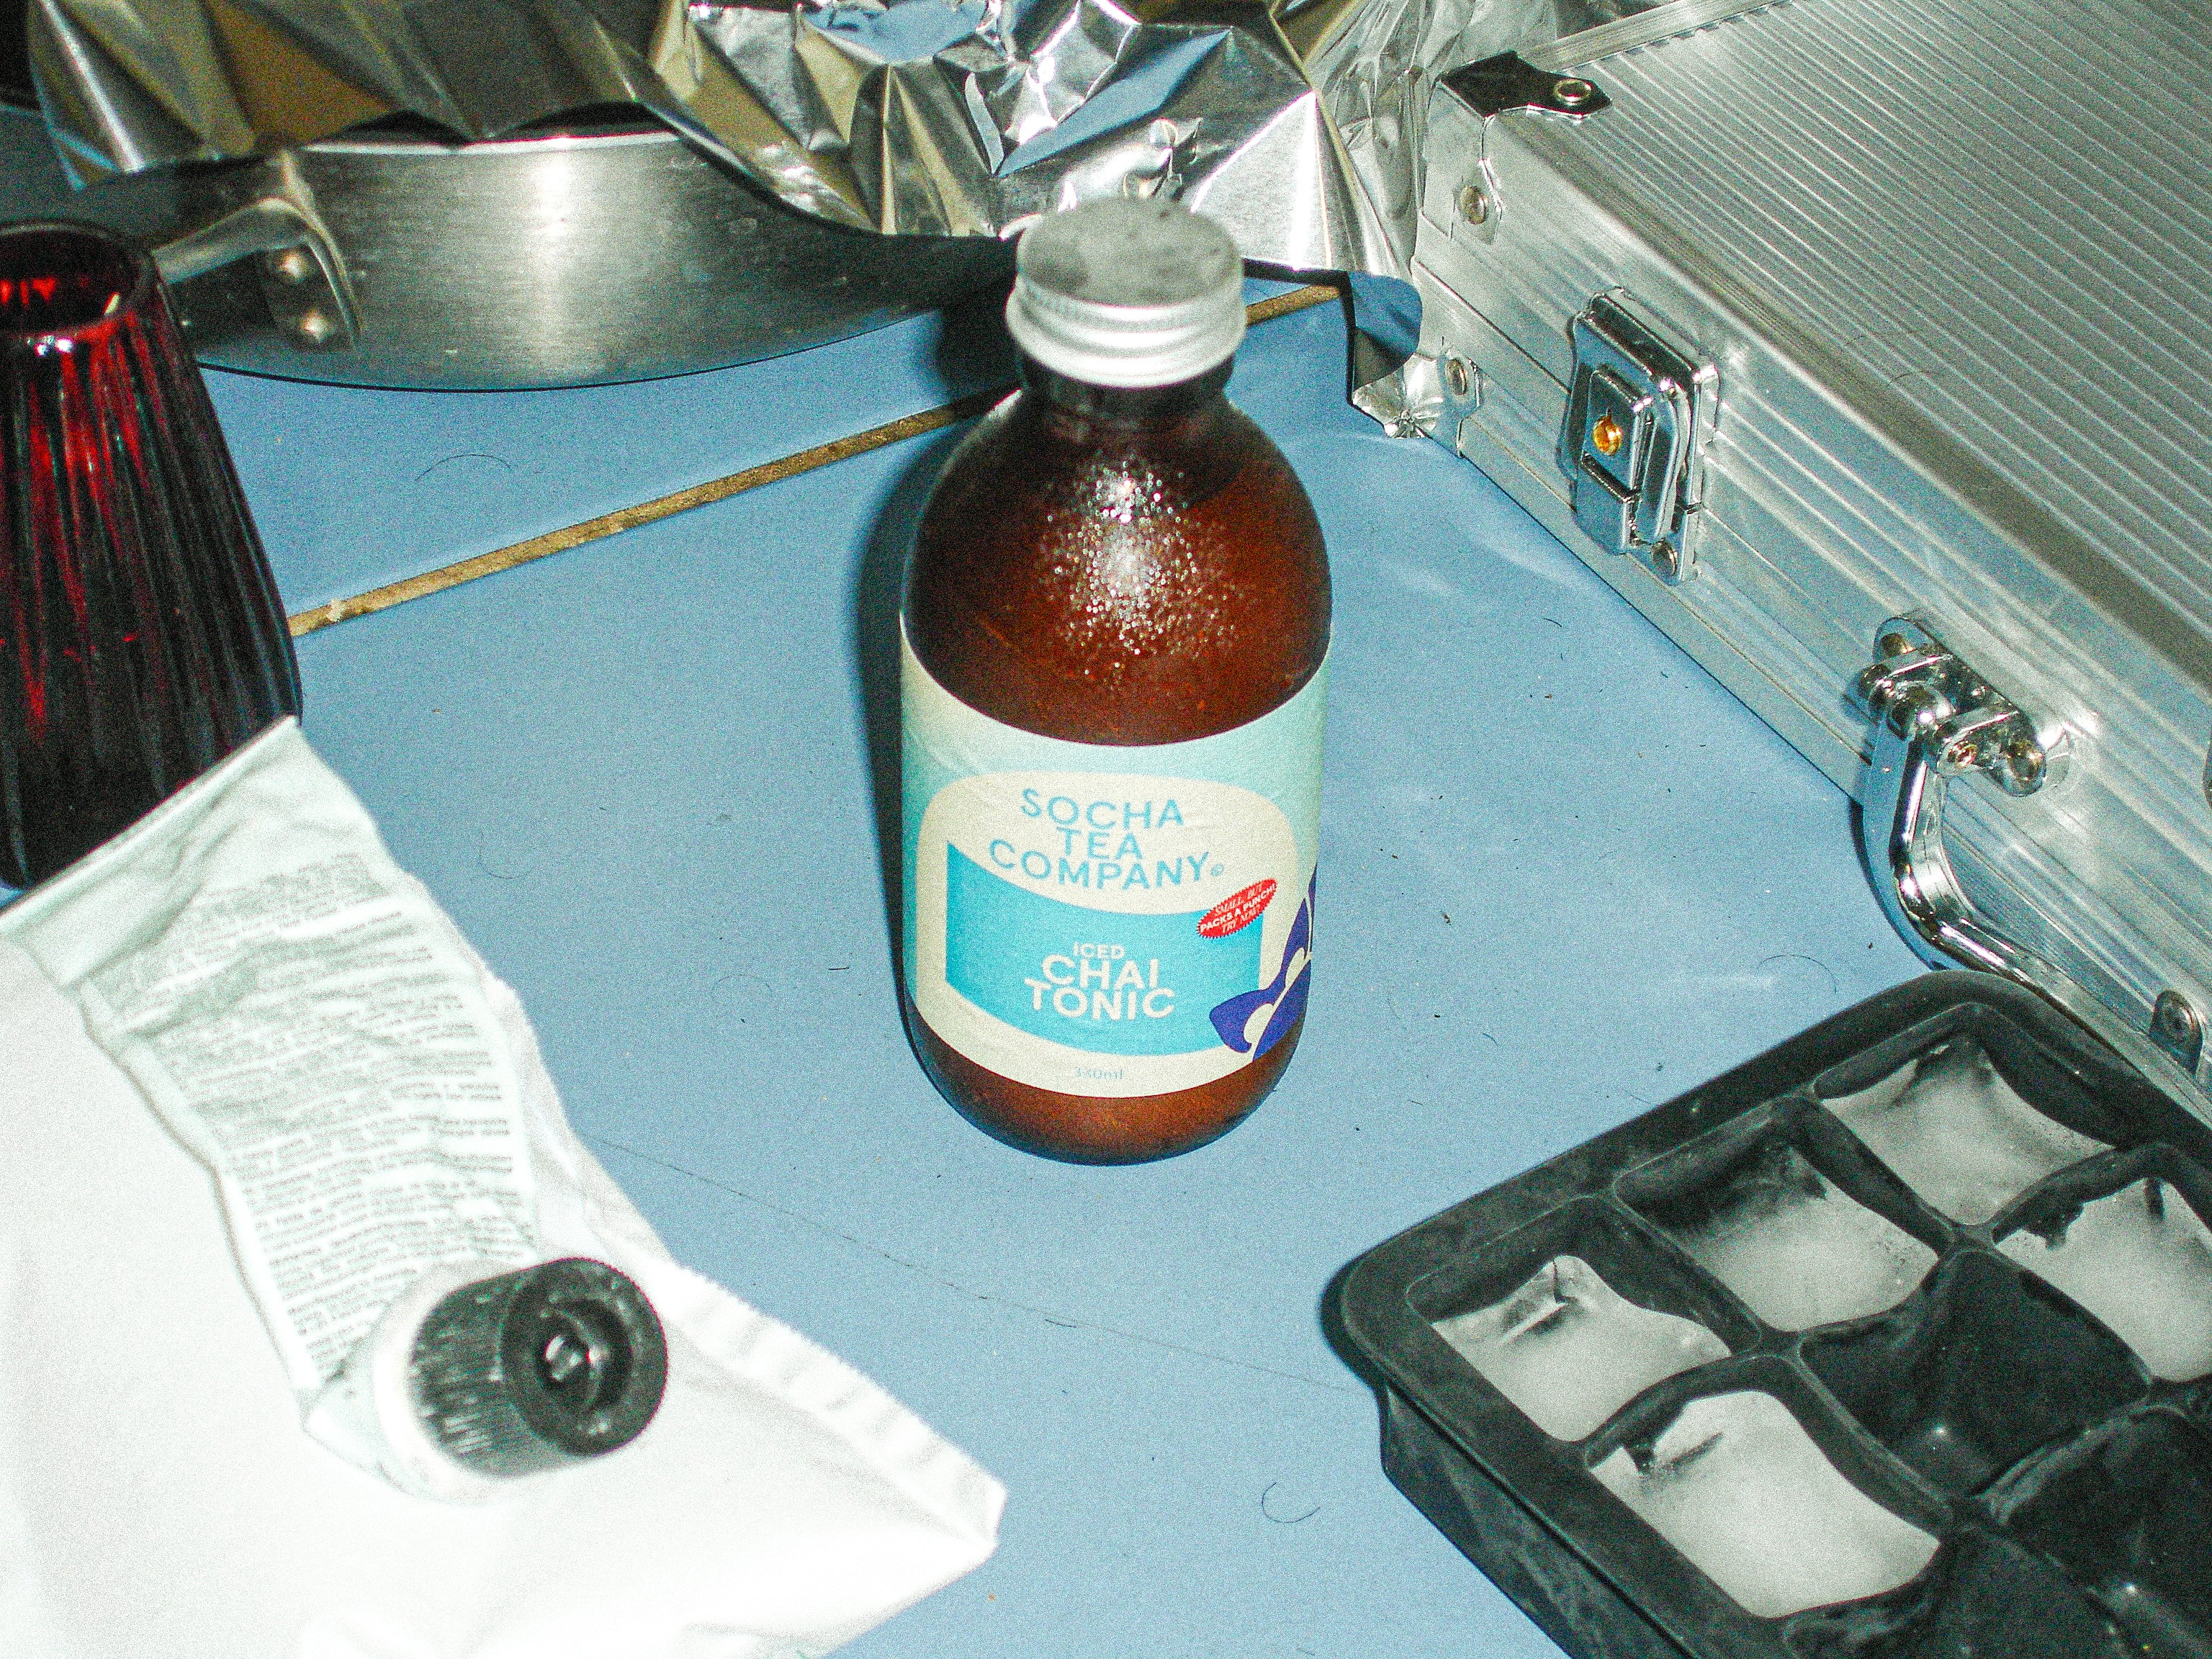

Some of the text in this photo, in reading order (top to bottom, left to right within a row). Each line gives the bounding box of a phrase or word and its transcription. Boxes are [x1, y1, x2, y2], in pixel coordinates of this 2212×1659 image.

[1020, 788, 1184, 830] SOCHA
[1056, 826, 1143, 860] TEA
[1199, 883, 1277, 933] PACKS A PUNCH!
[1073, 940, 1125, 961] ICED
[1041, 953, 1159, 991] CHAI
[1024, 977, 1177, 1022] TONIC
[1074, 1066, 1123, 1080] 330ml
